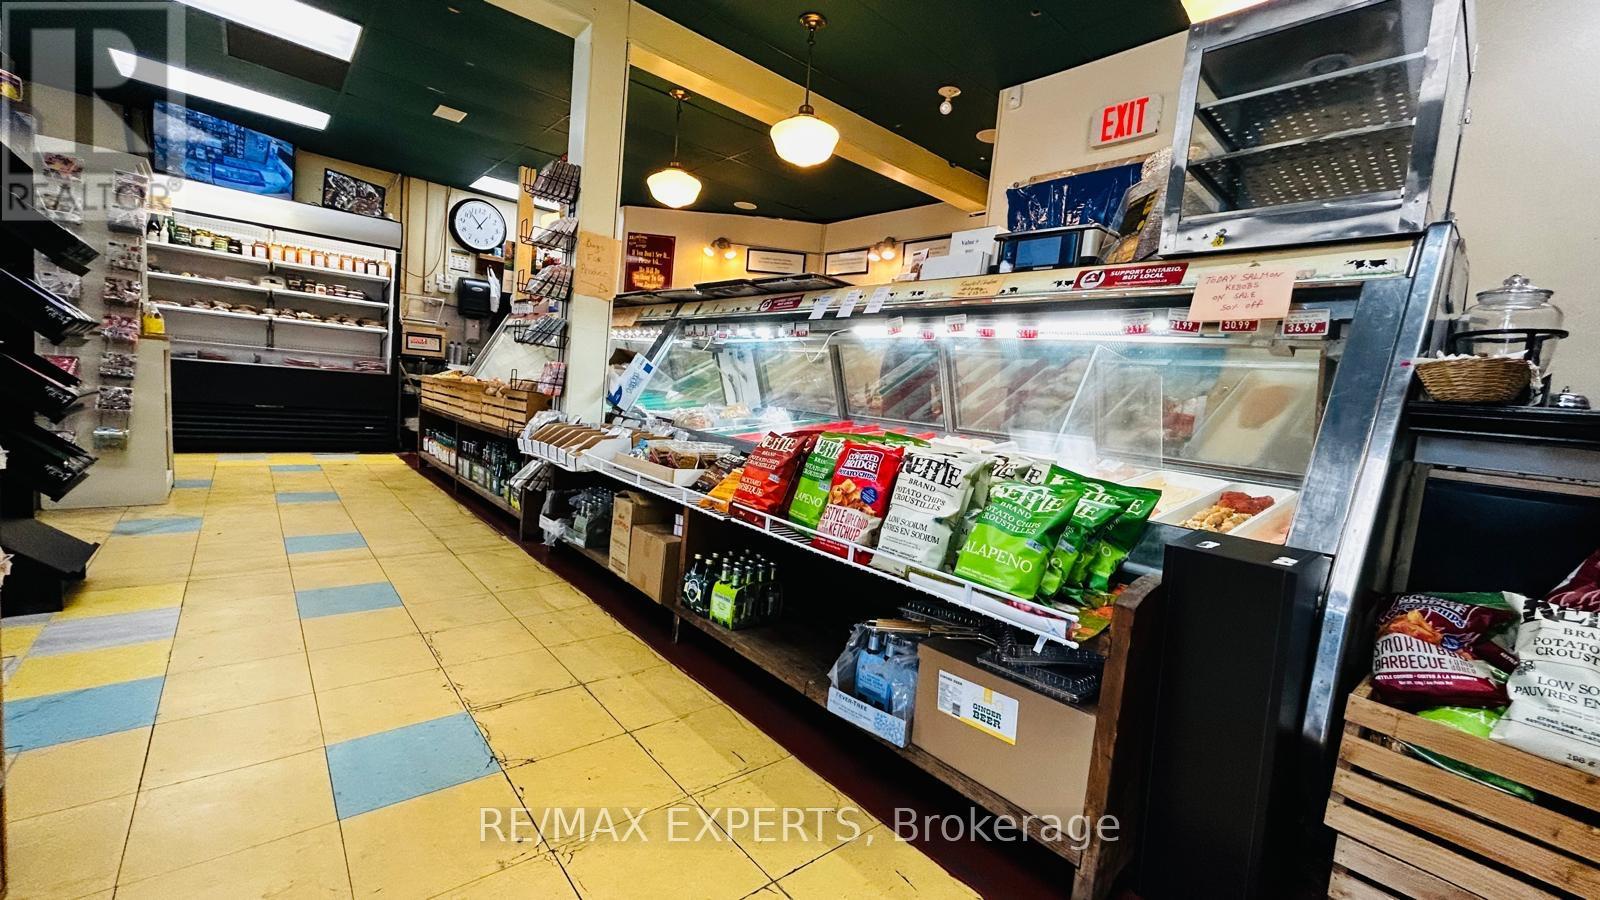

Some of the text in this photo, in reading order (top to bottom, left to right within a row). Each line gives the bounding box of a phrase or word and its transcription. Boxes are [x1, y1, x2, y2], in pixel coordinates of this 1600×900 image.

[1101, 97, 1149, 142] EXIT
[1110, 268, 1145, 277] SUPPORT
[1234, 292, 1256, 300] SALE
[1224, 321, 1250, 330] 30.99
[1288, 322, 1317, 332] 36.99
[844, 459, 878, 473] BRIDGE
[848, 451, 879, 463] COVERED
[902, 452, 962, 489] KETTLE
[908, 478, 936, 492] BRAND
[894, 492, 942, 512] CROUSTILLES
[922, 494, 946, 506] CHIPS
[986, 504, 1042, 529] OTATO CHIPS
[1000, 502, 1032, 519] BRAND
[829, 521, 861, 542] KETCHUP
[888, 514, 928, 532] LOW SODIUM
[900, 526, 910, 536] EN
[911, 531, 940, 545] SODIUM
[962, 540, 1033, 573] ALAPENO
[1533, 636, 1600, 655] POTATO
[1375, 654, 1448, 672] BARBECUE
[1538, 676, 1574, 692] LOW
[836, 692, 868, 712] FEVER-TREE
[1514, 686, 1578, 705] PAUVRES
[972, 702, 1002, 721] GINGER
[972, 710, 1001, 730] BEER
